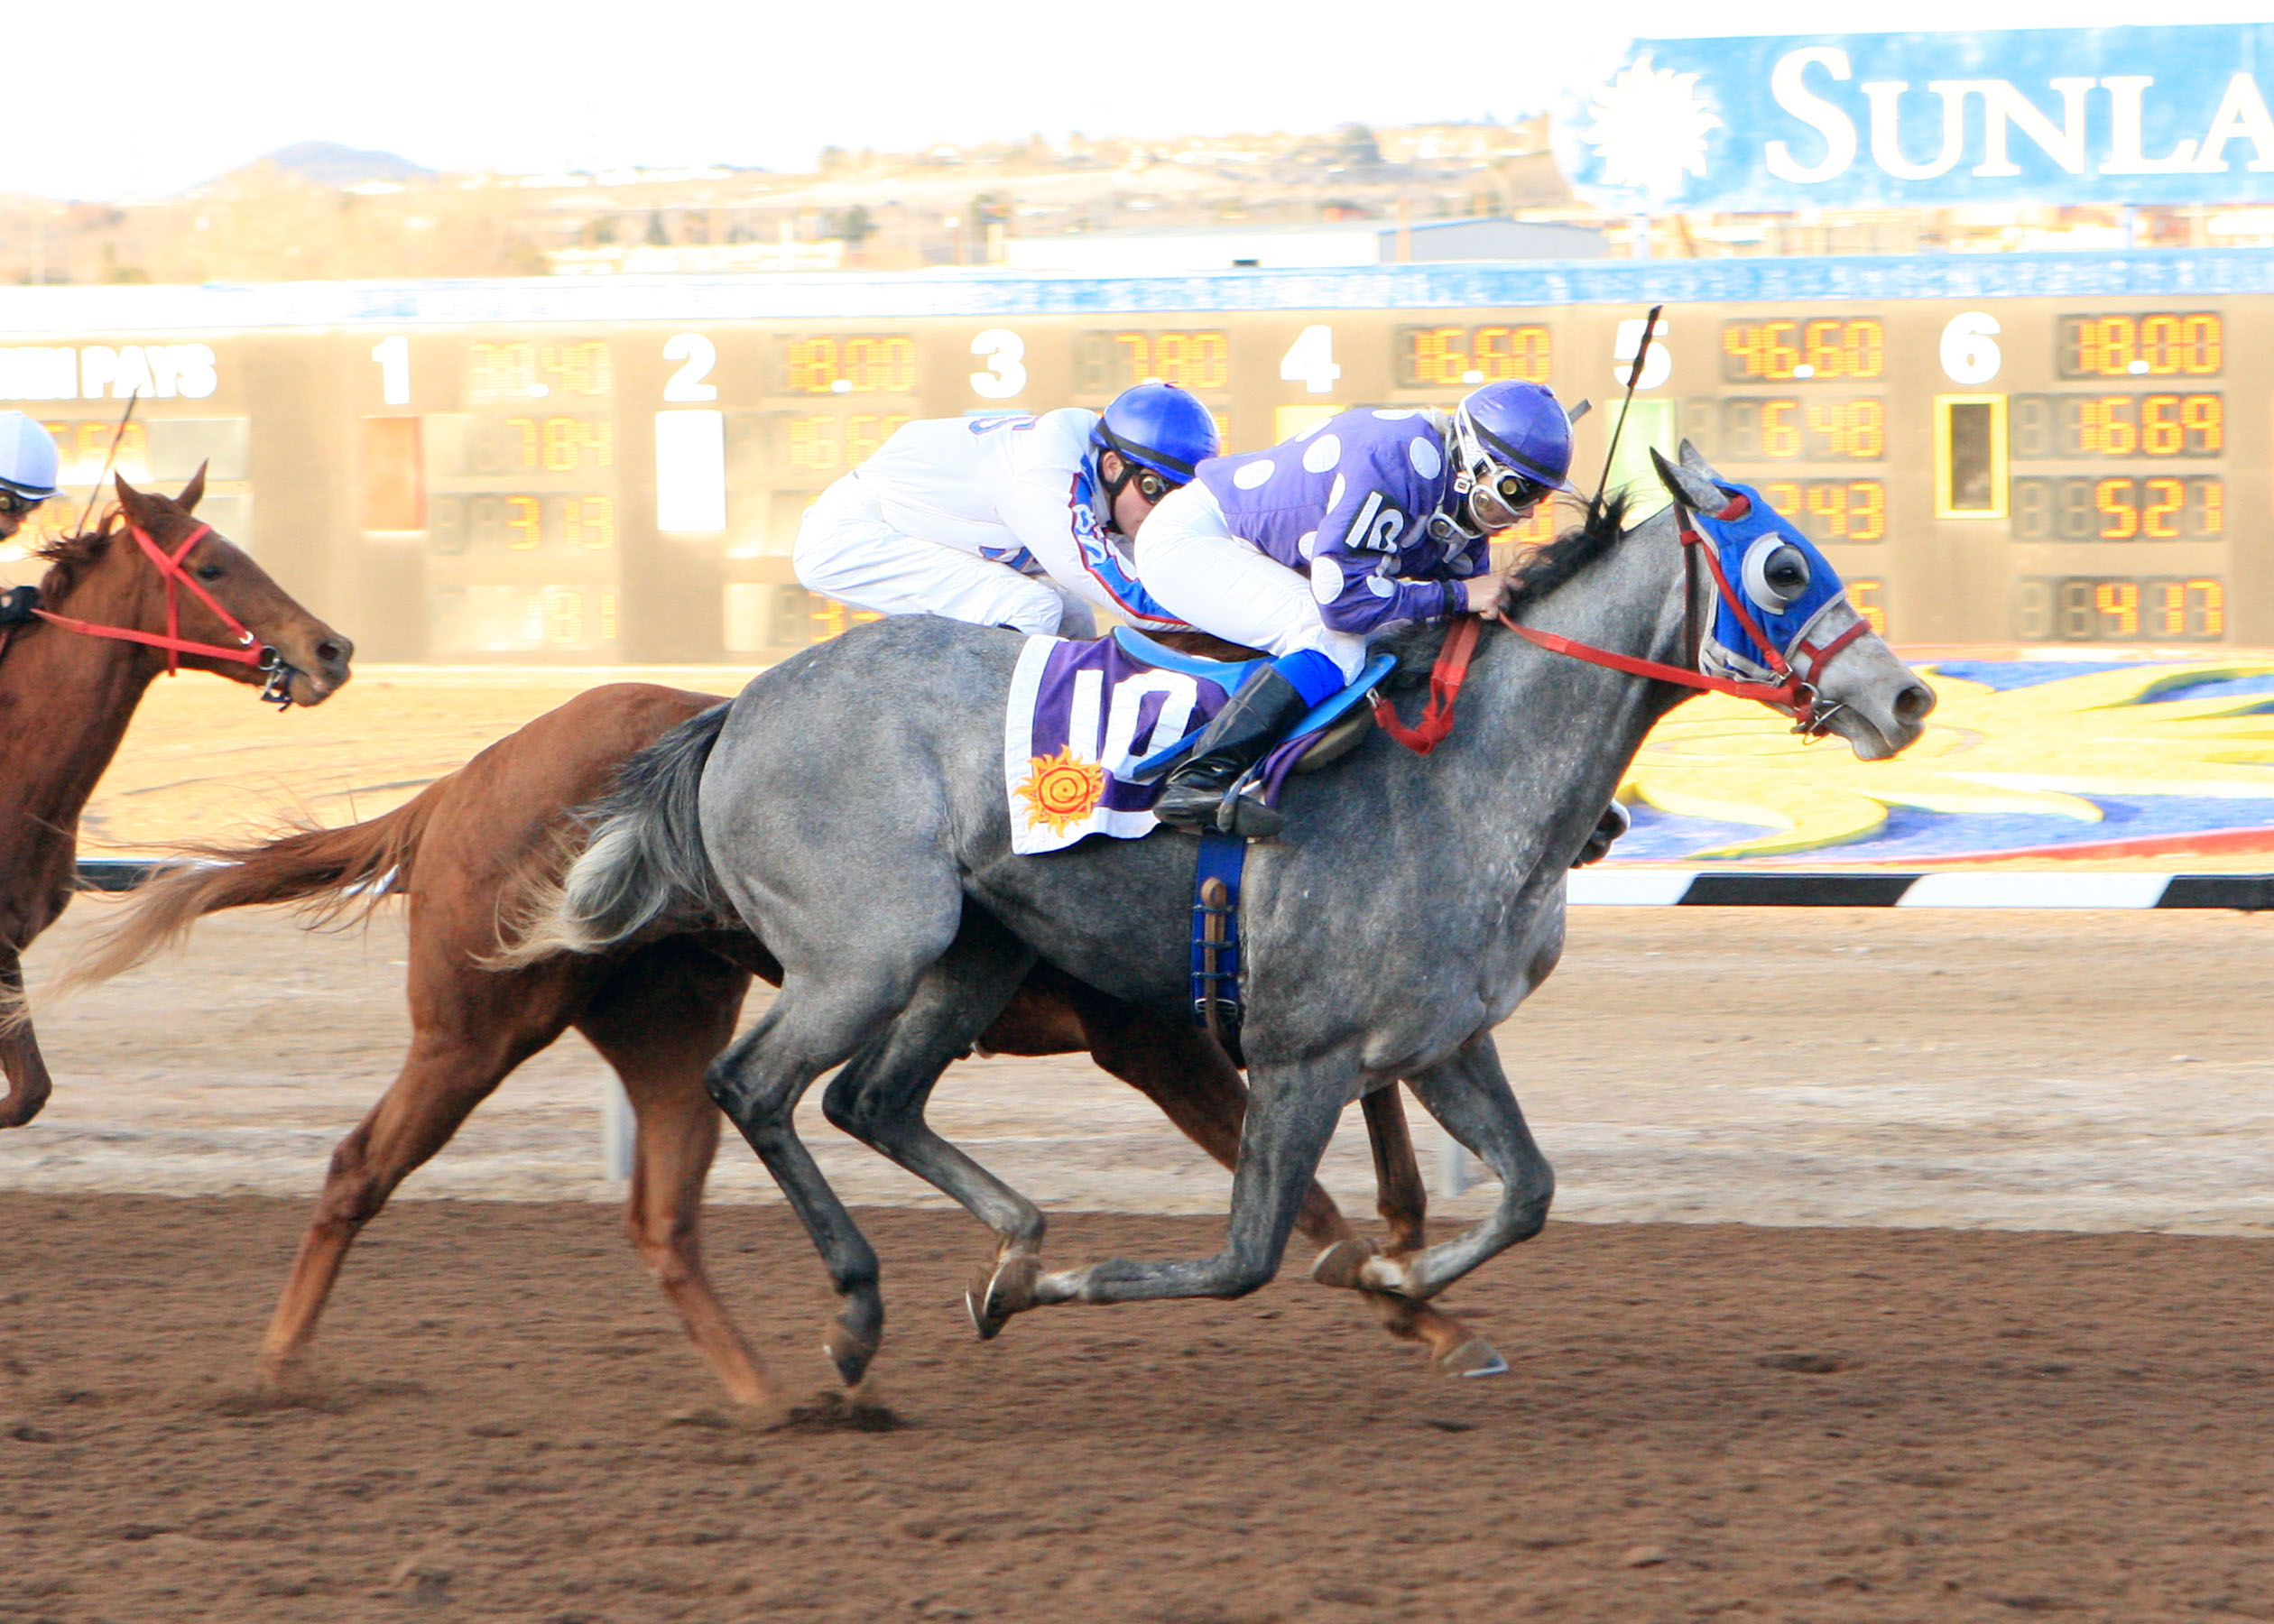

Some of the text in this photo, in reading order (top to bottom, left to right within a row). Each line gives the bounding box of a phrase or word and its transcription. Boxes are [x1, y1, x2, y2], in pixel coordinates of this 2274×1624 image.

[1764, 45, 2274, 184] SUNLA
[81, 344, 217, 399] PAYS
[372, 336, 411, 405] 1
[662, 333, 717, 401] 2
[969, 328, 1027, 399] 3
[1280, 325, 1341, 393] 4
[1414, 326, 1553, 384] 16.60
[1613, 318, 1671, 390] 5
[1722, 318, 1886, 378] 46.60
[1939, 311, 2001, 385] 6
[2078, 314, 2223, 374] 18.00
[1068, 669, 1198, 778] 10
